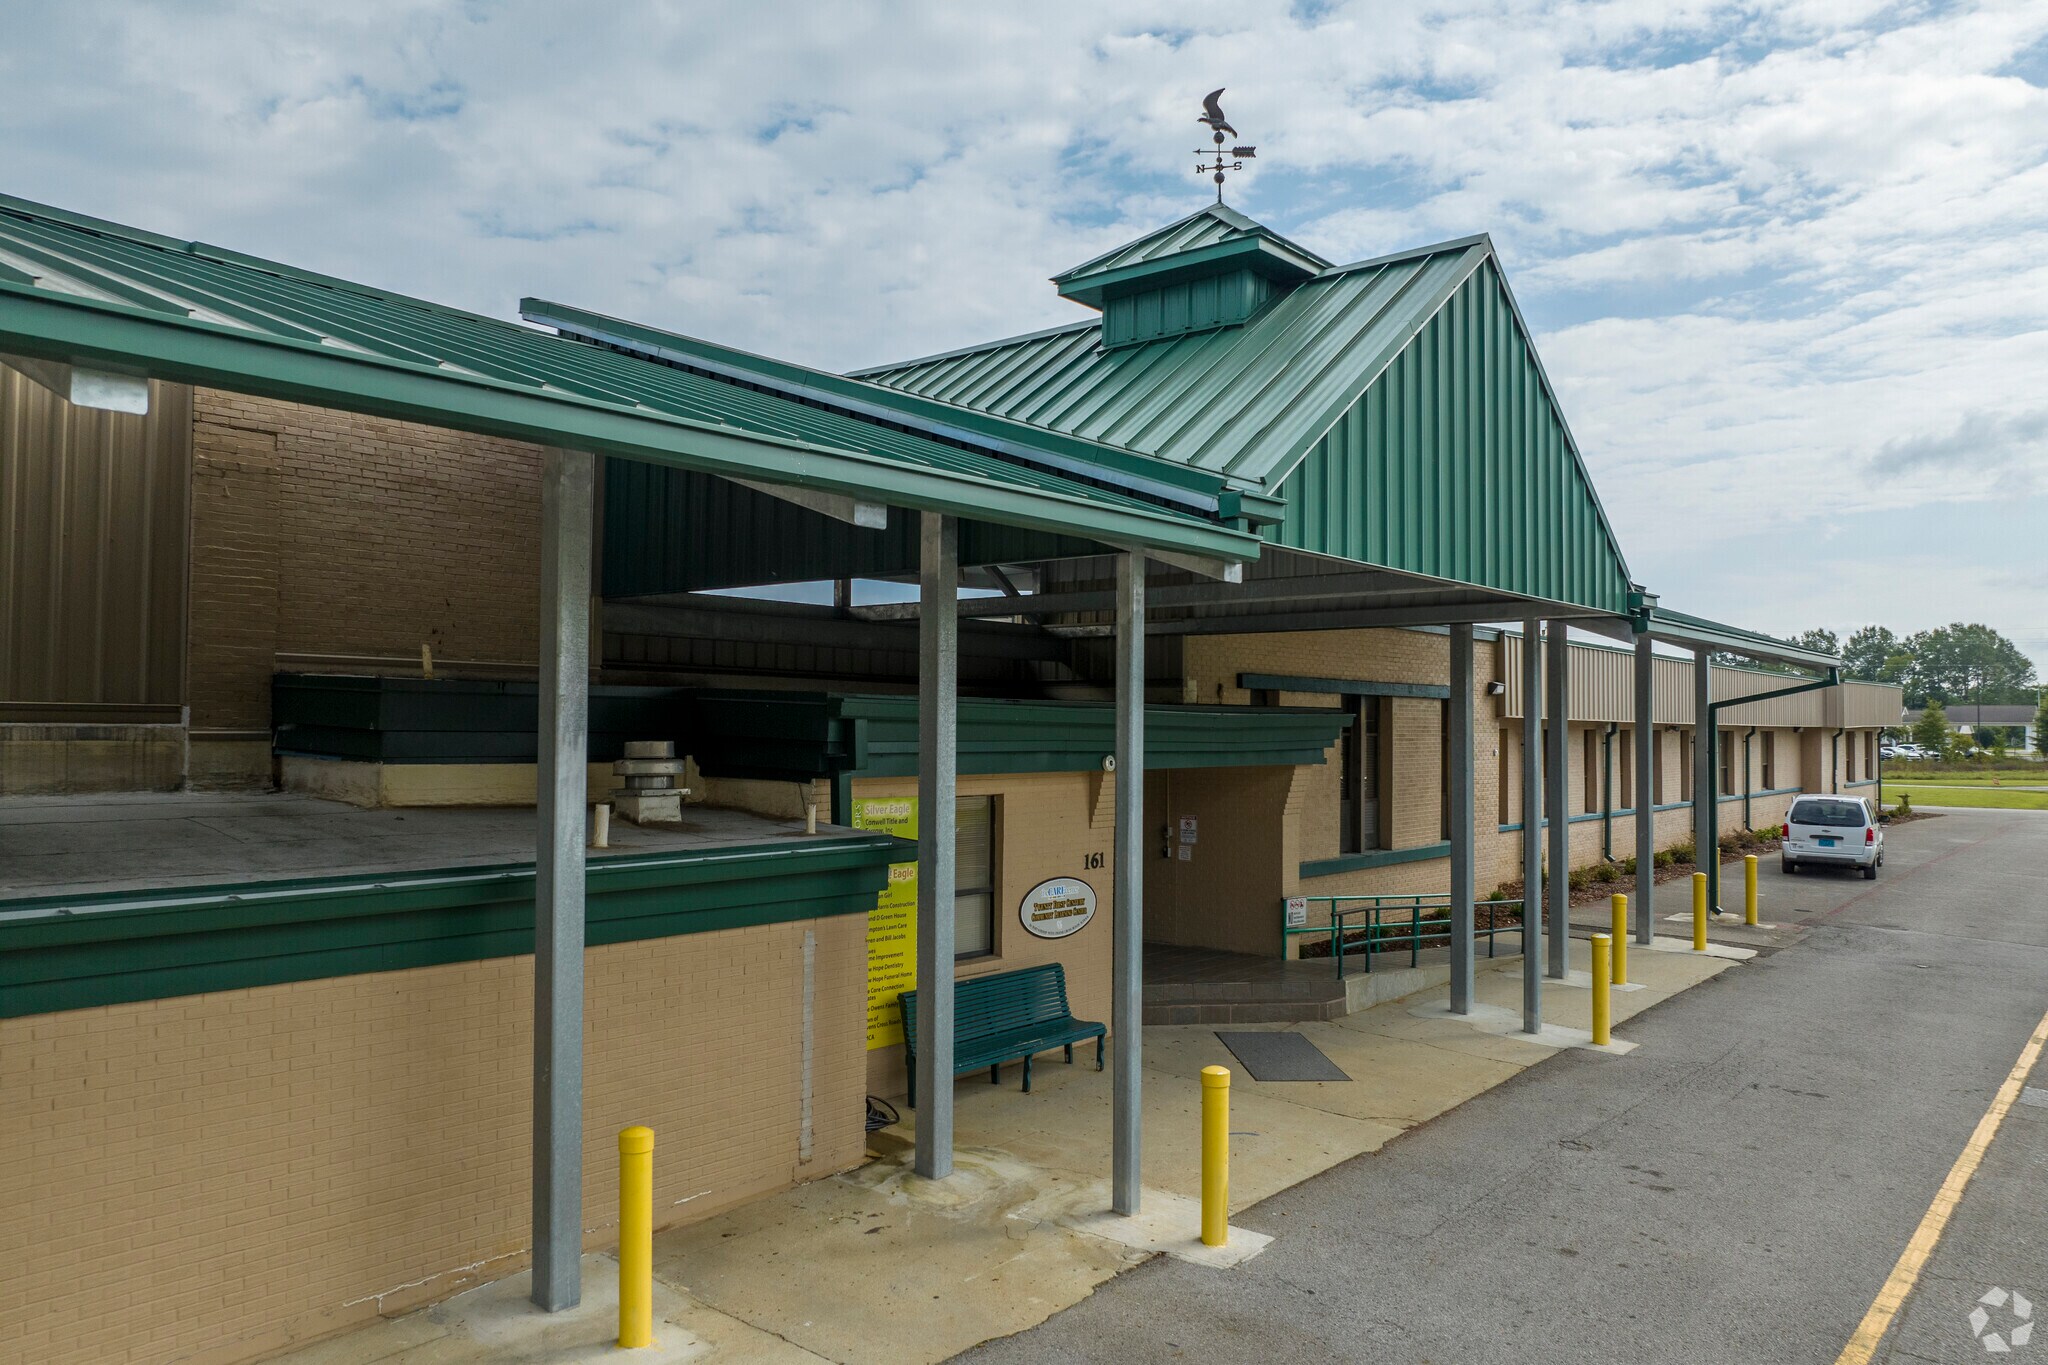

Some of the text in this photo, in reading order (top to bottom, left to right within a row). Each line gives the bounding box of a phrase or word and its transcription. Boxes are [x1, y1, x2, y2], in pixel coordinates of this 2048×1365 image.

[1196, 165, 1205, 173] N
[1234, 162, 1242, 170] S
[865, 803, 910, 816] Silver Eagle
[865, 818, 885, 826] Conwell
[886, 817, 897, 825] Title
[1084, 852, 1105, 870] 161
[893, 868, 914, 880] Eagle
[876, 952, 904, 960] Improvement
[882, 983, 905, 991] Connection
[871, 1004, 884, 1012] Owens
